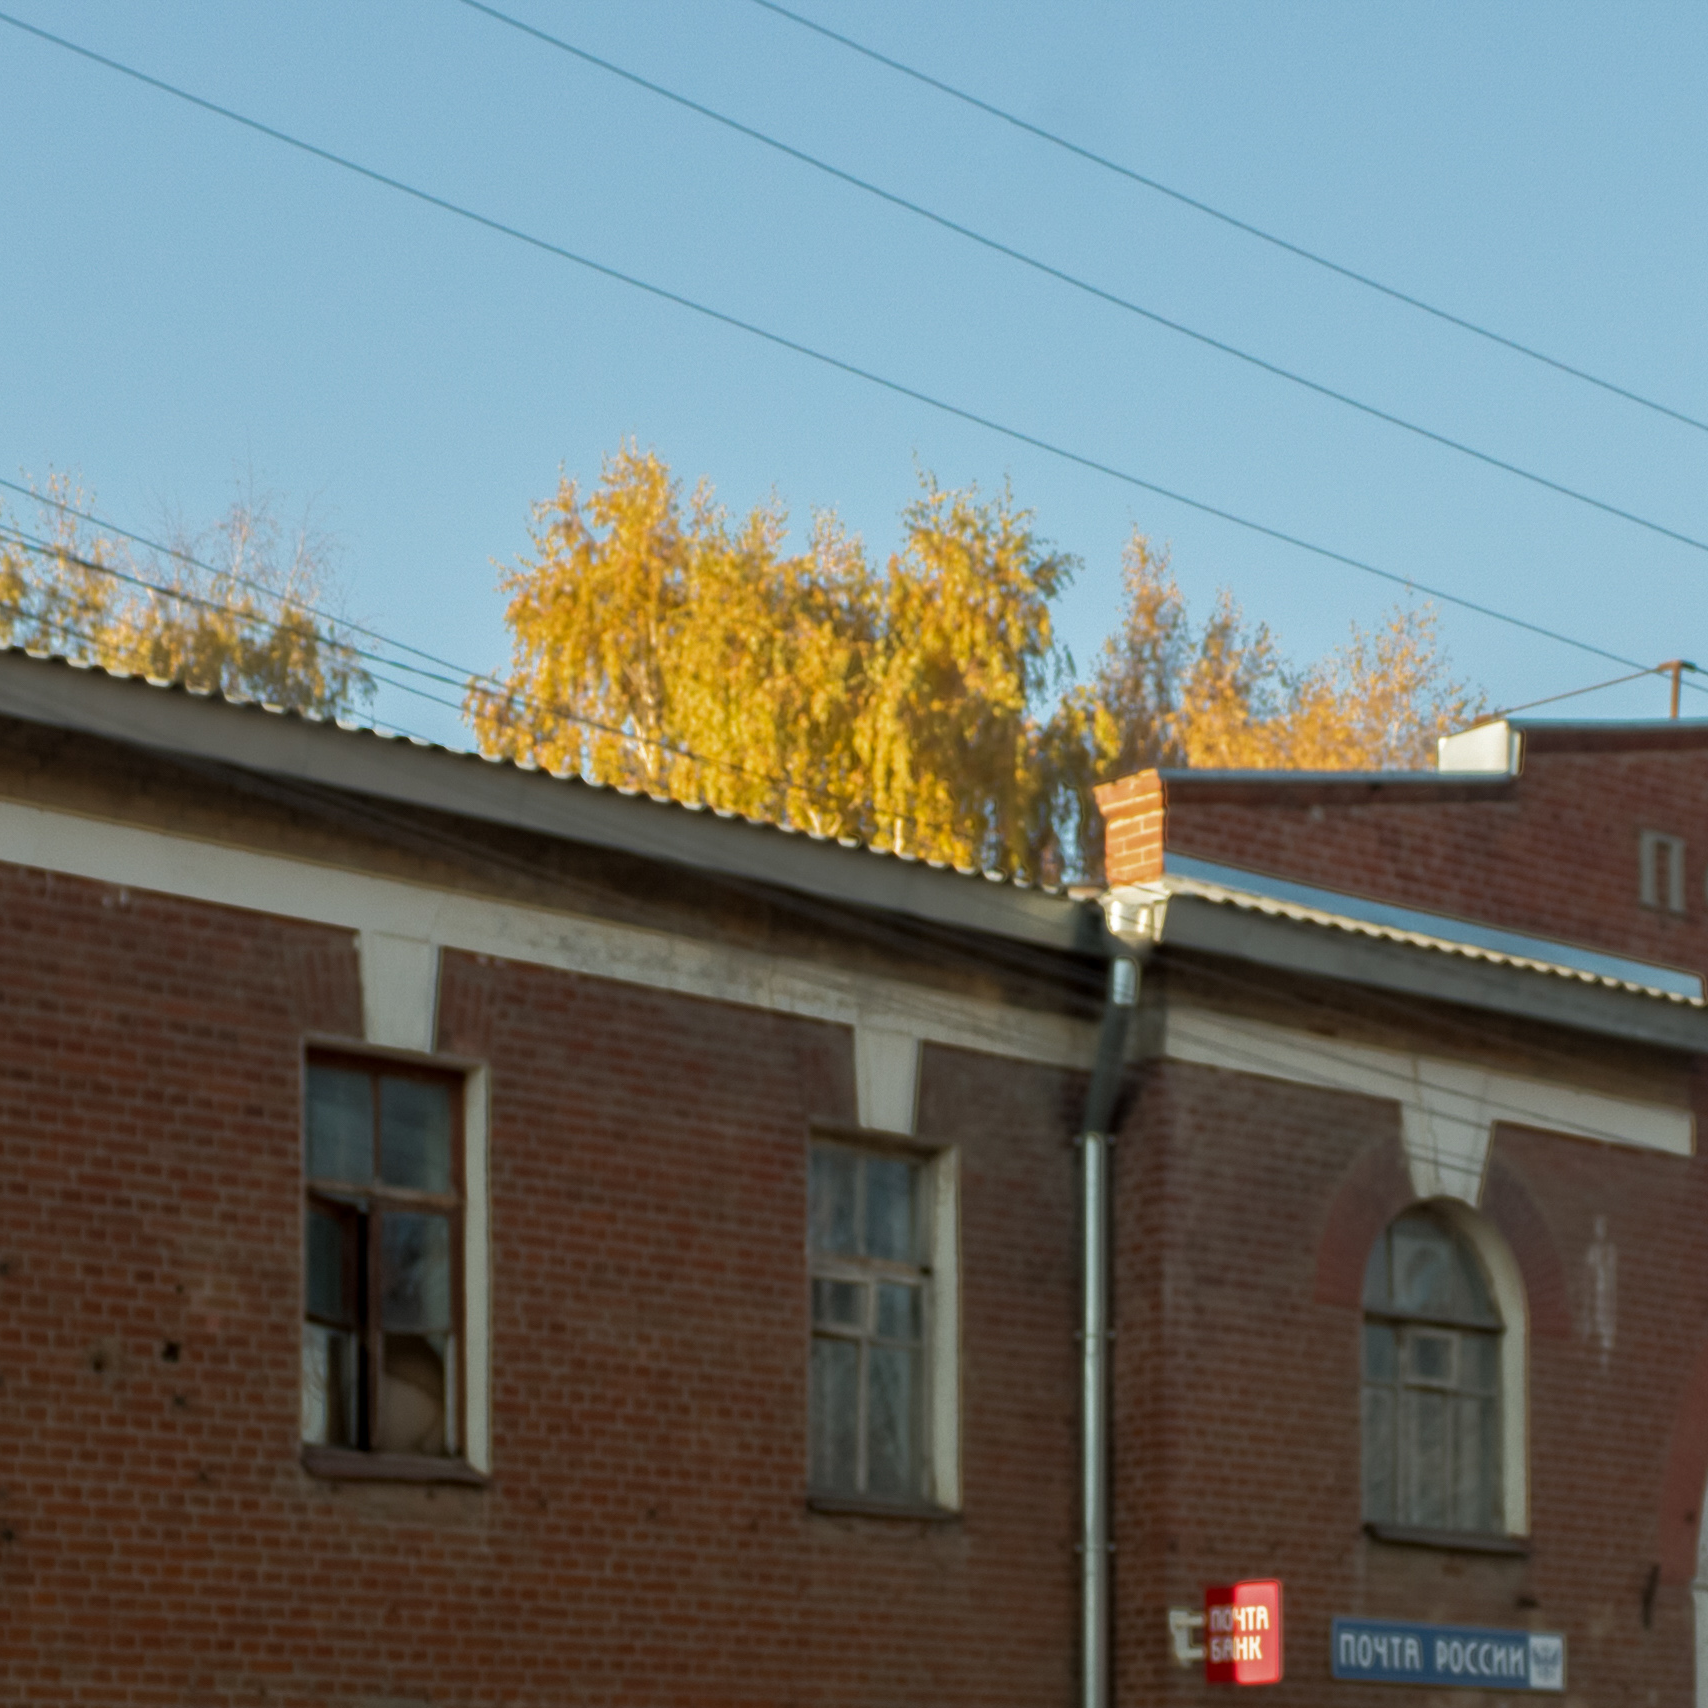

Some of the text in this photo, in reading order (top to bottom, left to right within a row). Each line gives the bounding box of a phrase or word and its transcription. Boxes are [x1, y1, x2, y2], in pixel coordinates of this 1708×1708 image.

[1210, 1605, 1269, 1632] ПОЧТА
[1210, 1635, 1263, 1662] БАНК
[1339, 1632, 1526, 1677] ПОЧТА РОССИИ
